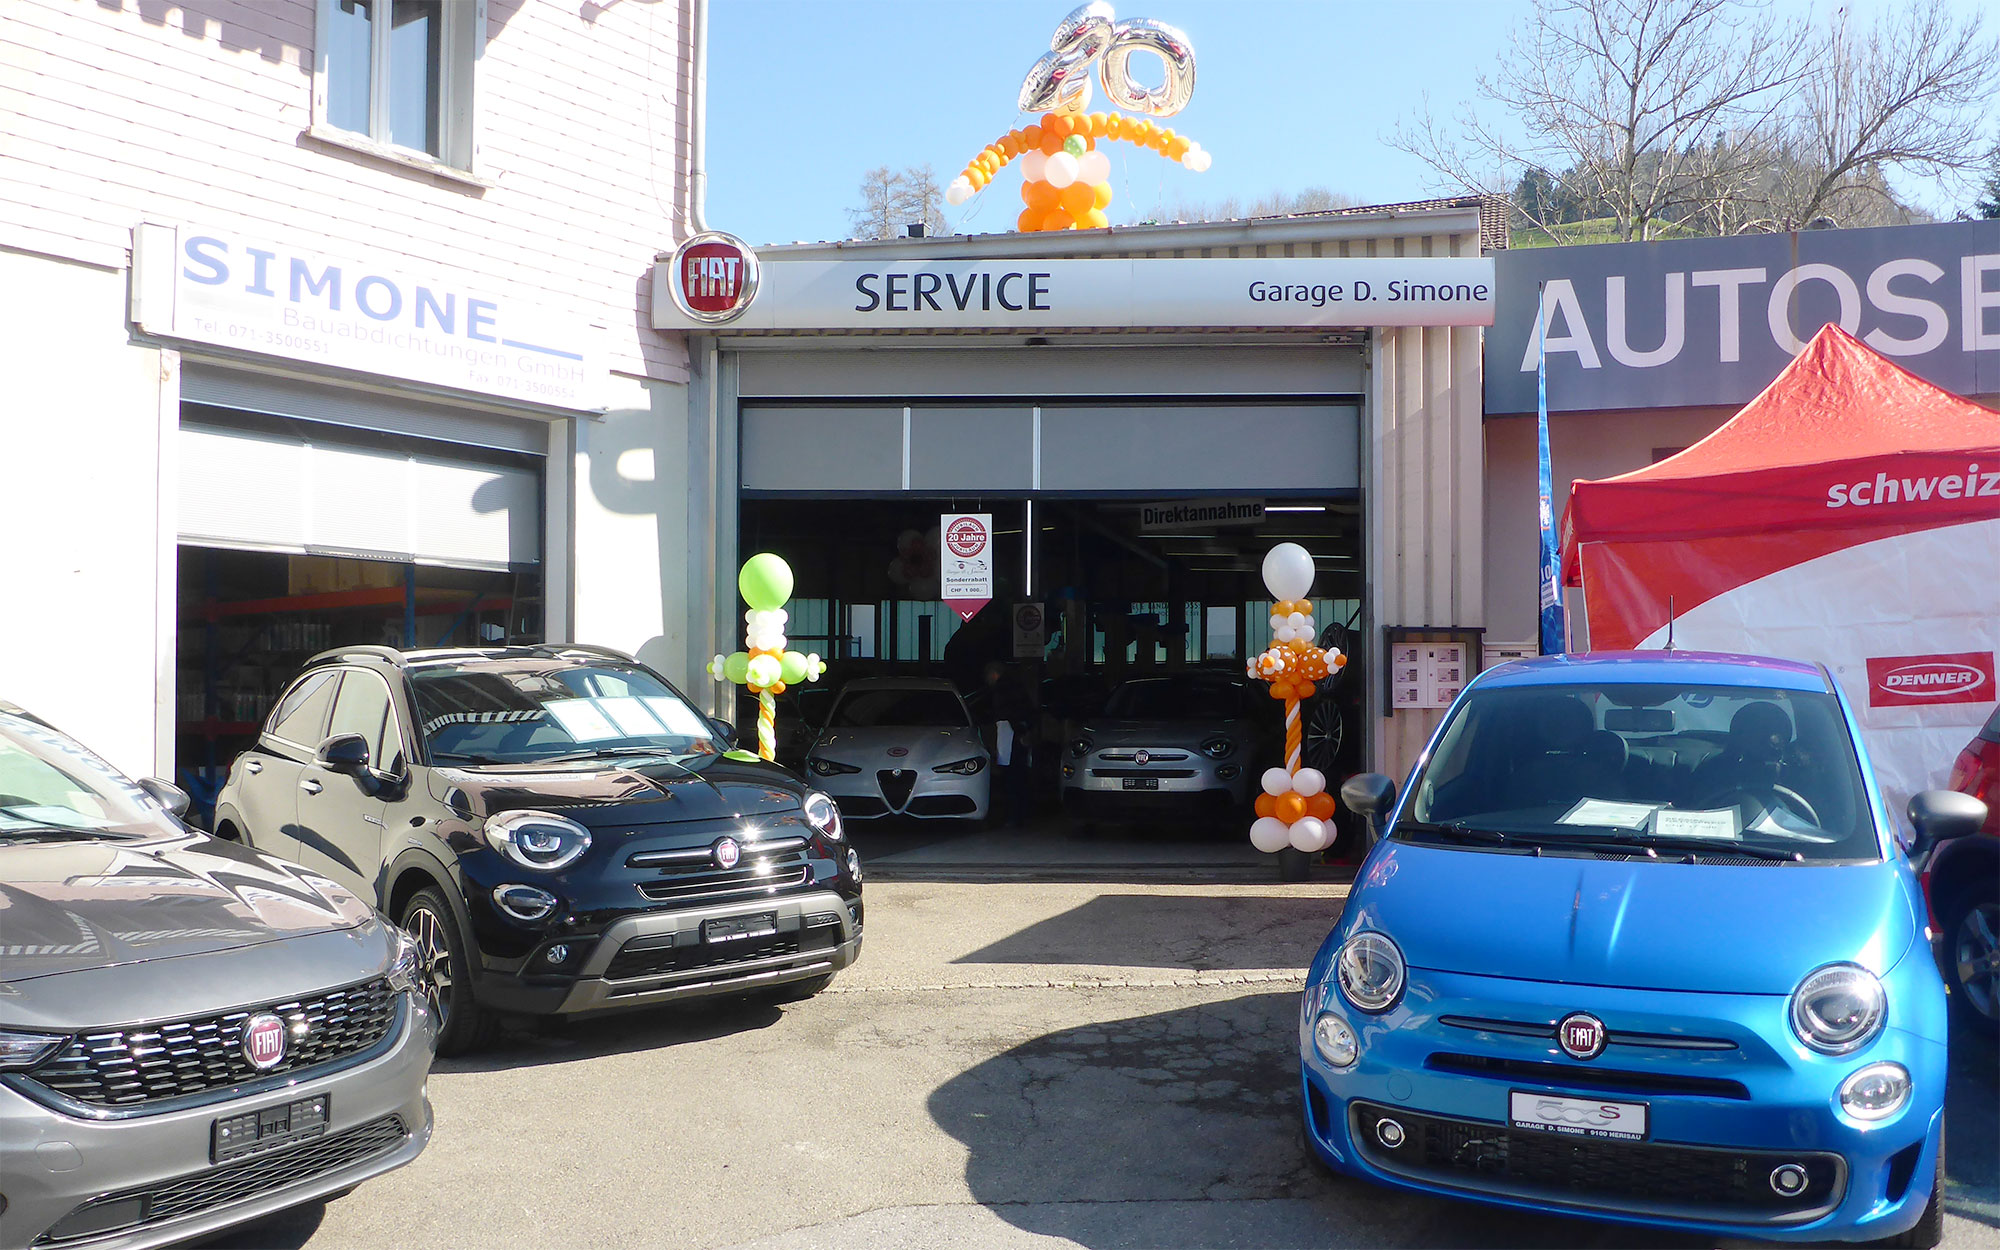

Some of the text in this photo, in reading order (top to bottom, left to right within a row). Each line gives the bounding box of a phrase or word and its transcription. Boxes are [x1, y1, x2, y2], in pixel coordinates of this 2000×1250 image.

[184, 236, 498, 344] SIMONE
[688, 257, 740, 297] FIAT
[855, 272, 1051, 312] SERVICE
[1248, 279, 1488, 307] Garage D. Simone
[1520, 254, 2000, 372] AUTOSE
[194, 317, 329, 354] Tel. 071-3500551
[283, 307, 585, 383] Bauabdichtungen GmbH
[1826, 463, 2000, 508] schweiz
[1144, 502, 1262, 525] Direktannahme
[948, 533, 985, 542] 20 Jahre
[1886, 672, 1972, 687] DENNER
[255, 1028, 280, 1056] FIAT
[1570, 1027, 1594, 1047] FIAT
[1599, 1105, 1621, 1119] S
[1515, 1121, 1545, 1130] GARAGE
[1557, 1126, 1585, 1135] SIMONE
[1590, 1129, 1608, 1137] 9100
[1609, 1131, 1642, 1141] HERISAU
